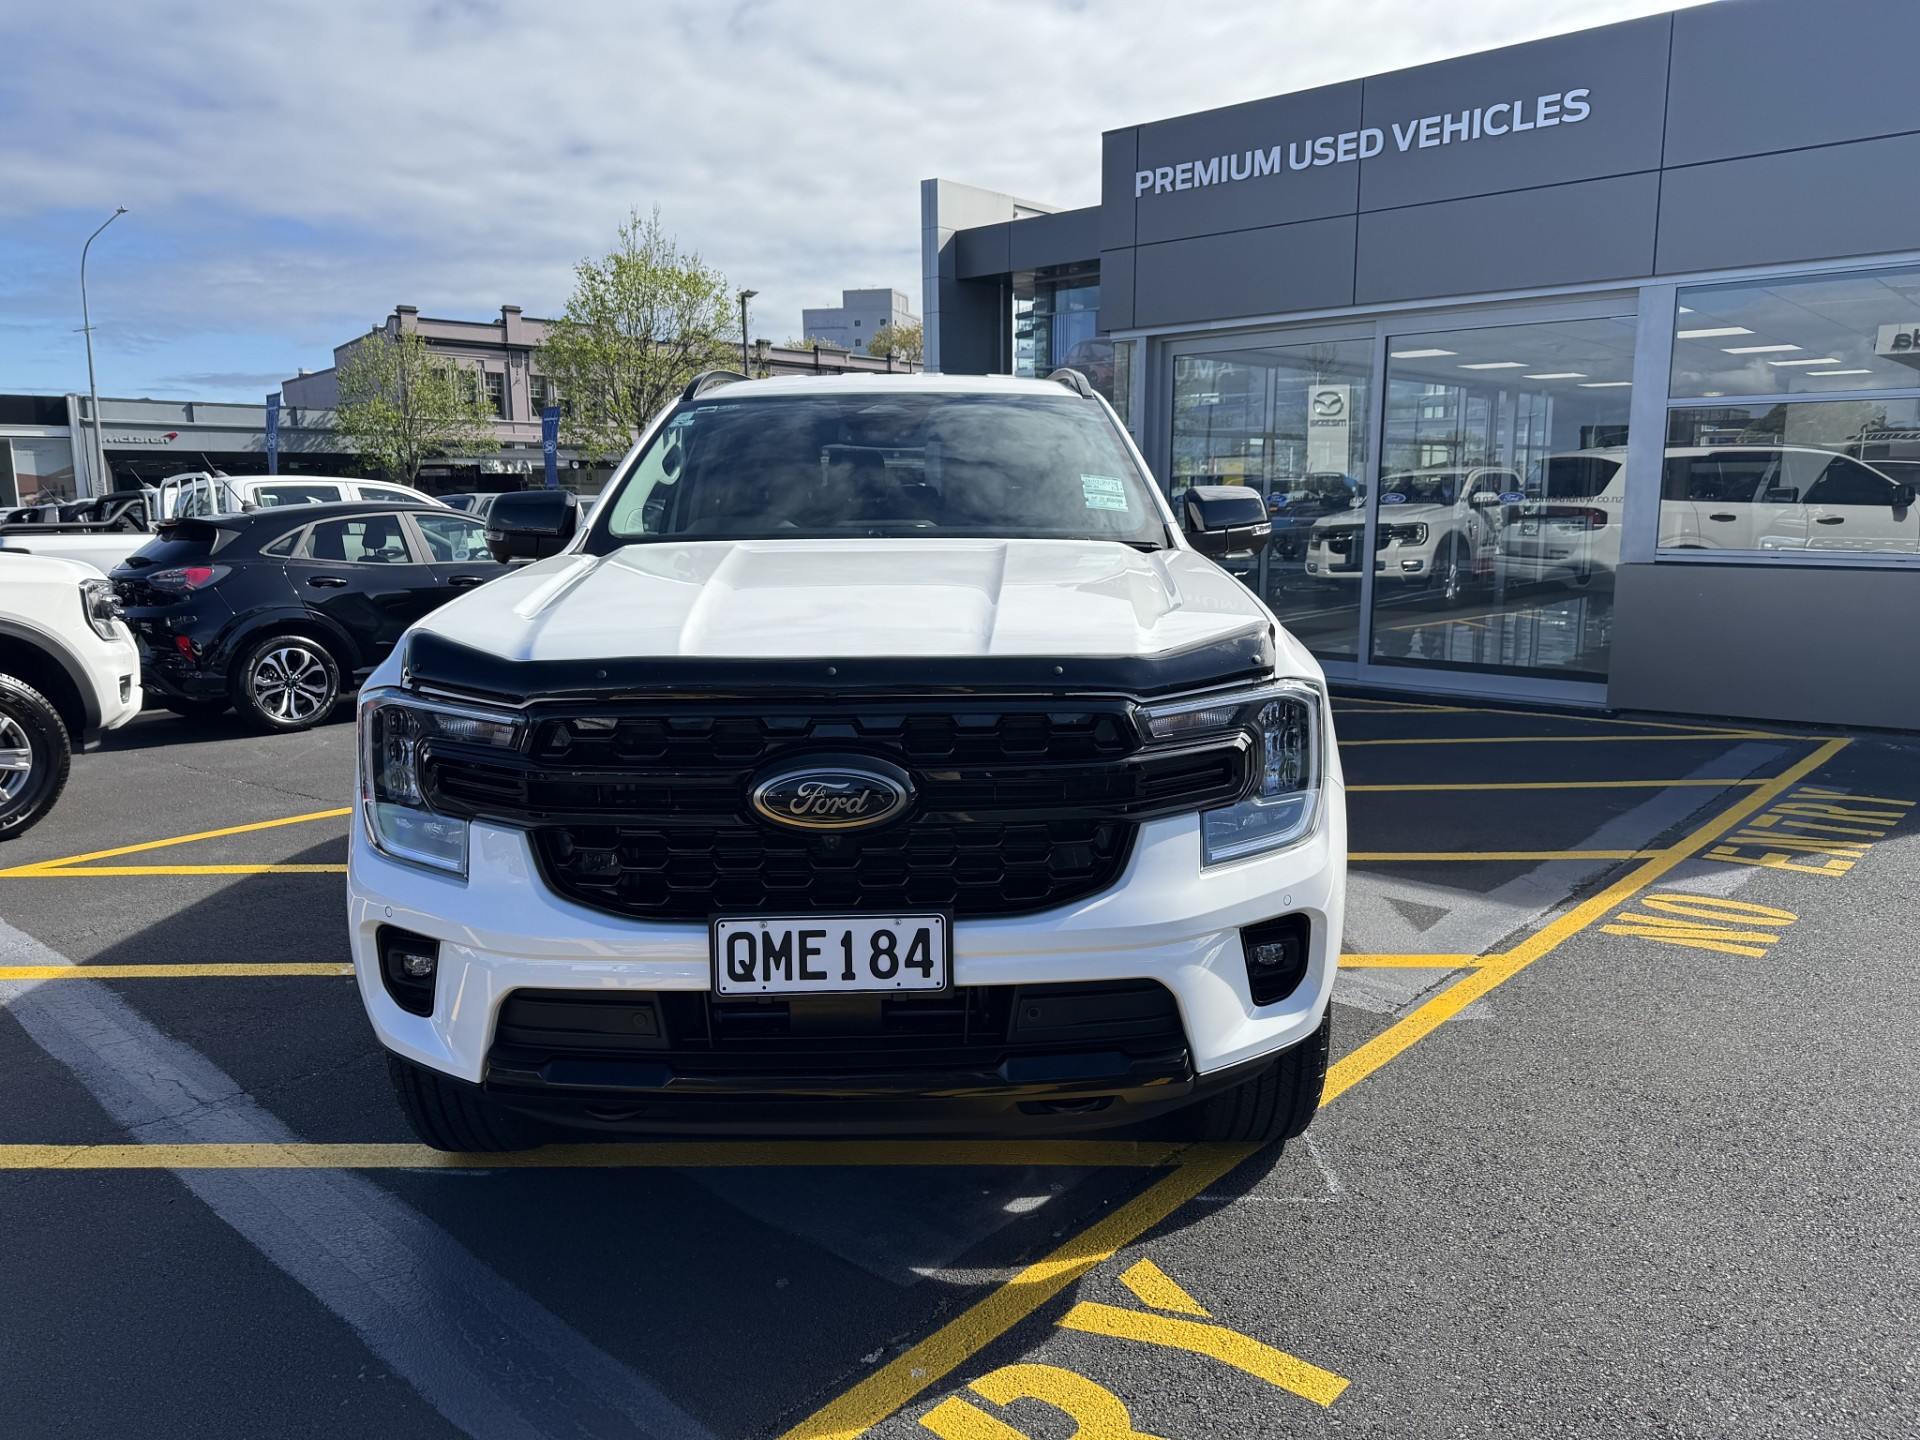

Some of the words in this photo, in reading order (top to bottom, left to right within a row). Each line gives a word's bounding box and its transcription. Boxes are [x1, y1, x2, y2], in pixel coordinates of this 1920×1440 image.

[1135, 145, 1281, 198] PREMIUM
[1288, 128, 1384, 170] USED
[1392, 88, 1591, 152] VEHICLES
[789, 781, 870, 814] Ford
[1599, 894, 1800, 958] NO
[1702, 786, 1917, 877] ENTRY
[727, 928, 934, 982] QME184
